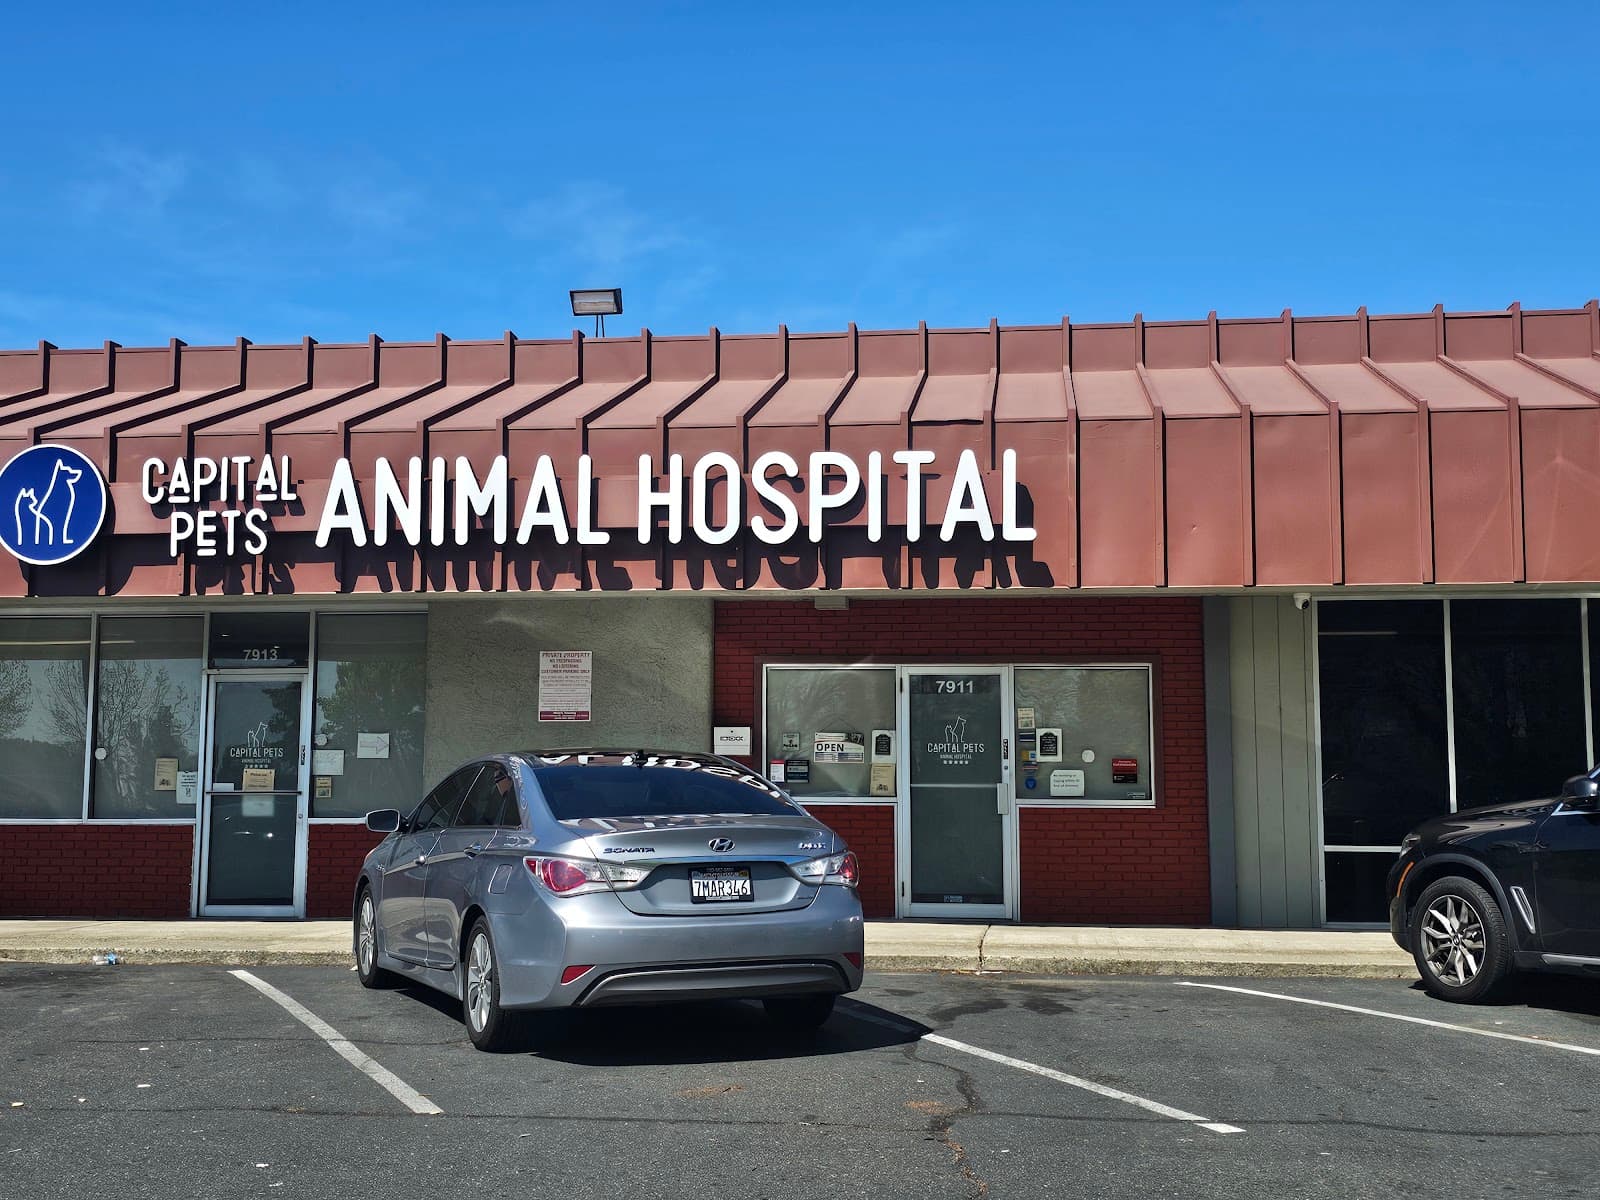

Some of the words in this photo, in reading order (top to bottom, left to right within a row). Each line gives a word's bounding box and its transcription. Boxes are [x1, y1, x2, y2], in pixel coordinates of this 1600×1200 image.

[142, 454, 297, 504] CAPITAL
[314, 453, 610, 548] ANIMAL
[636, 448, 1038, 545] HOSPITAL
[169, 508, 268, 557] PETS
[243, 649, 279, 661] 7913
[935, 680, 974, 694] 7911
[230, 747, 262, 758] CAPITAL
[263, 747, 284, 758] PETS
[816, 743, 845, 752] OPEN
[927, 742, 961, 753] CAPITAL
[963, 742, 985, 753] PETS
[694, 879, 749, 897] 7MAR346
